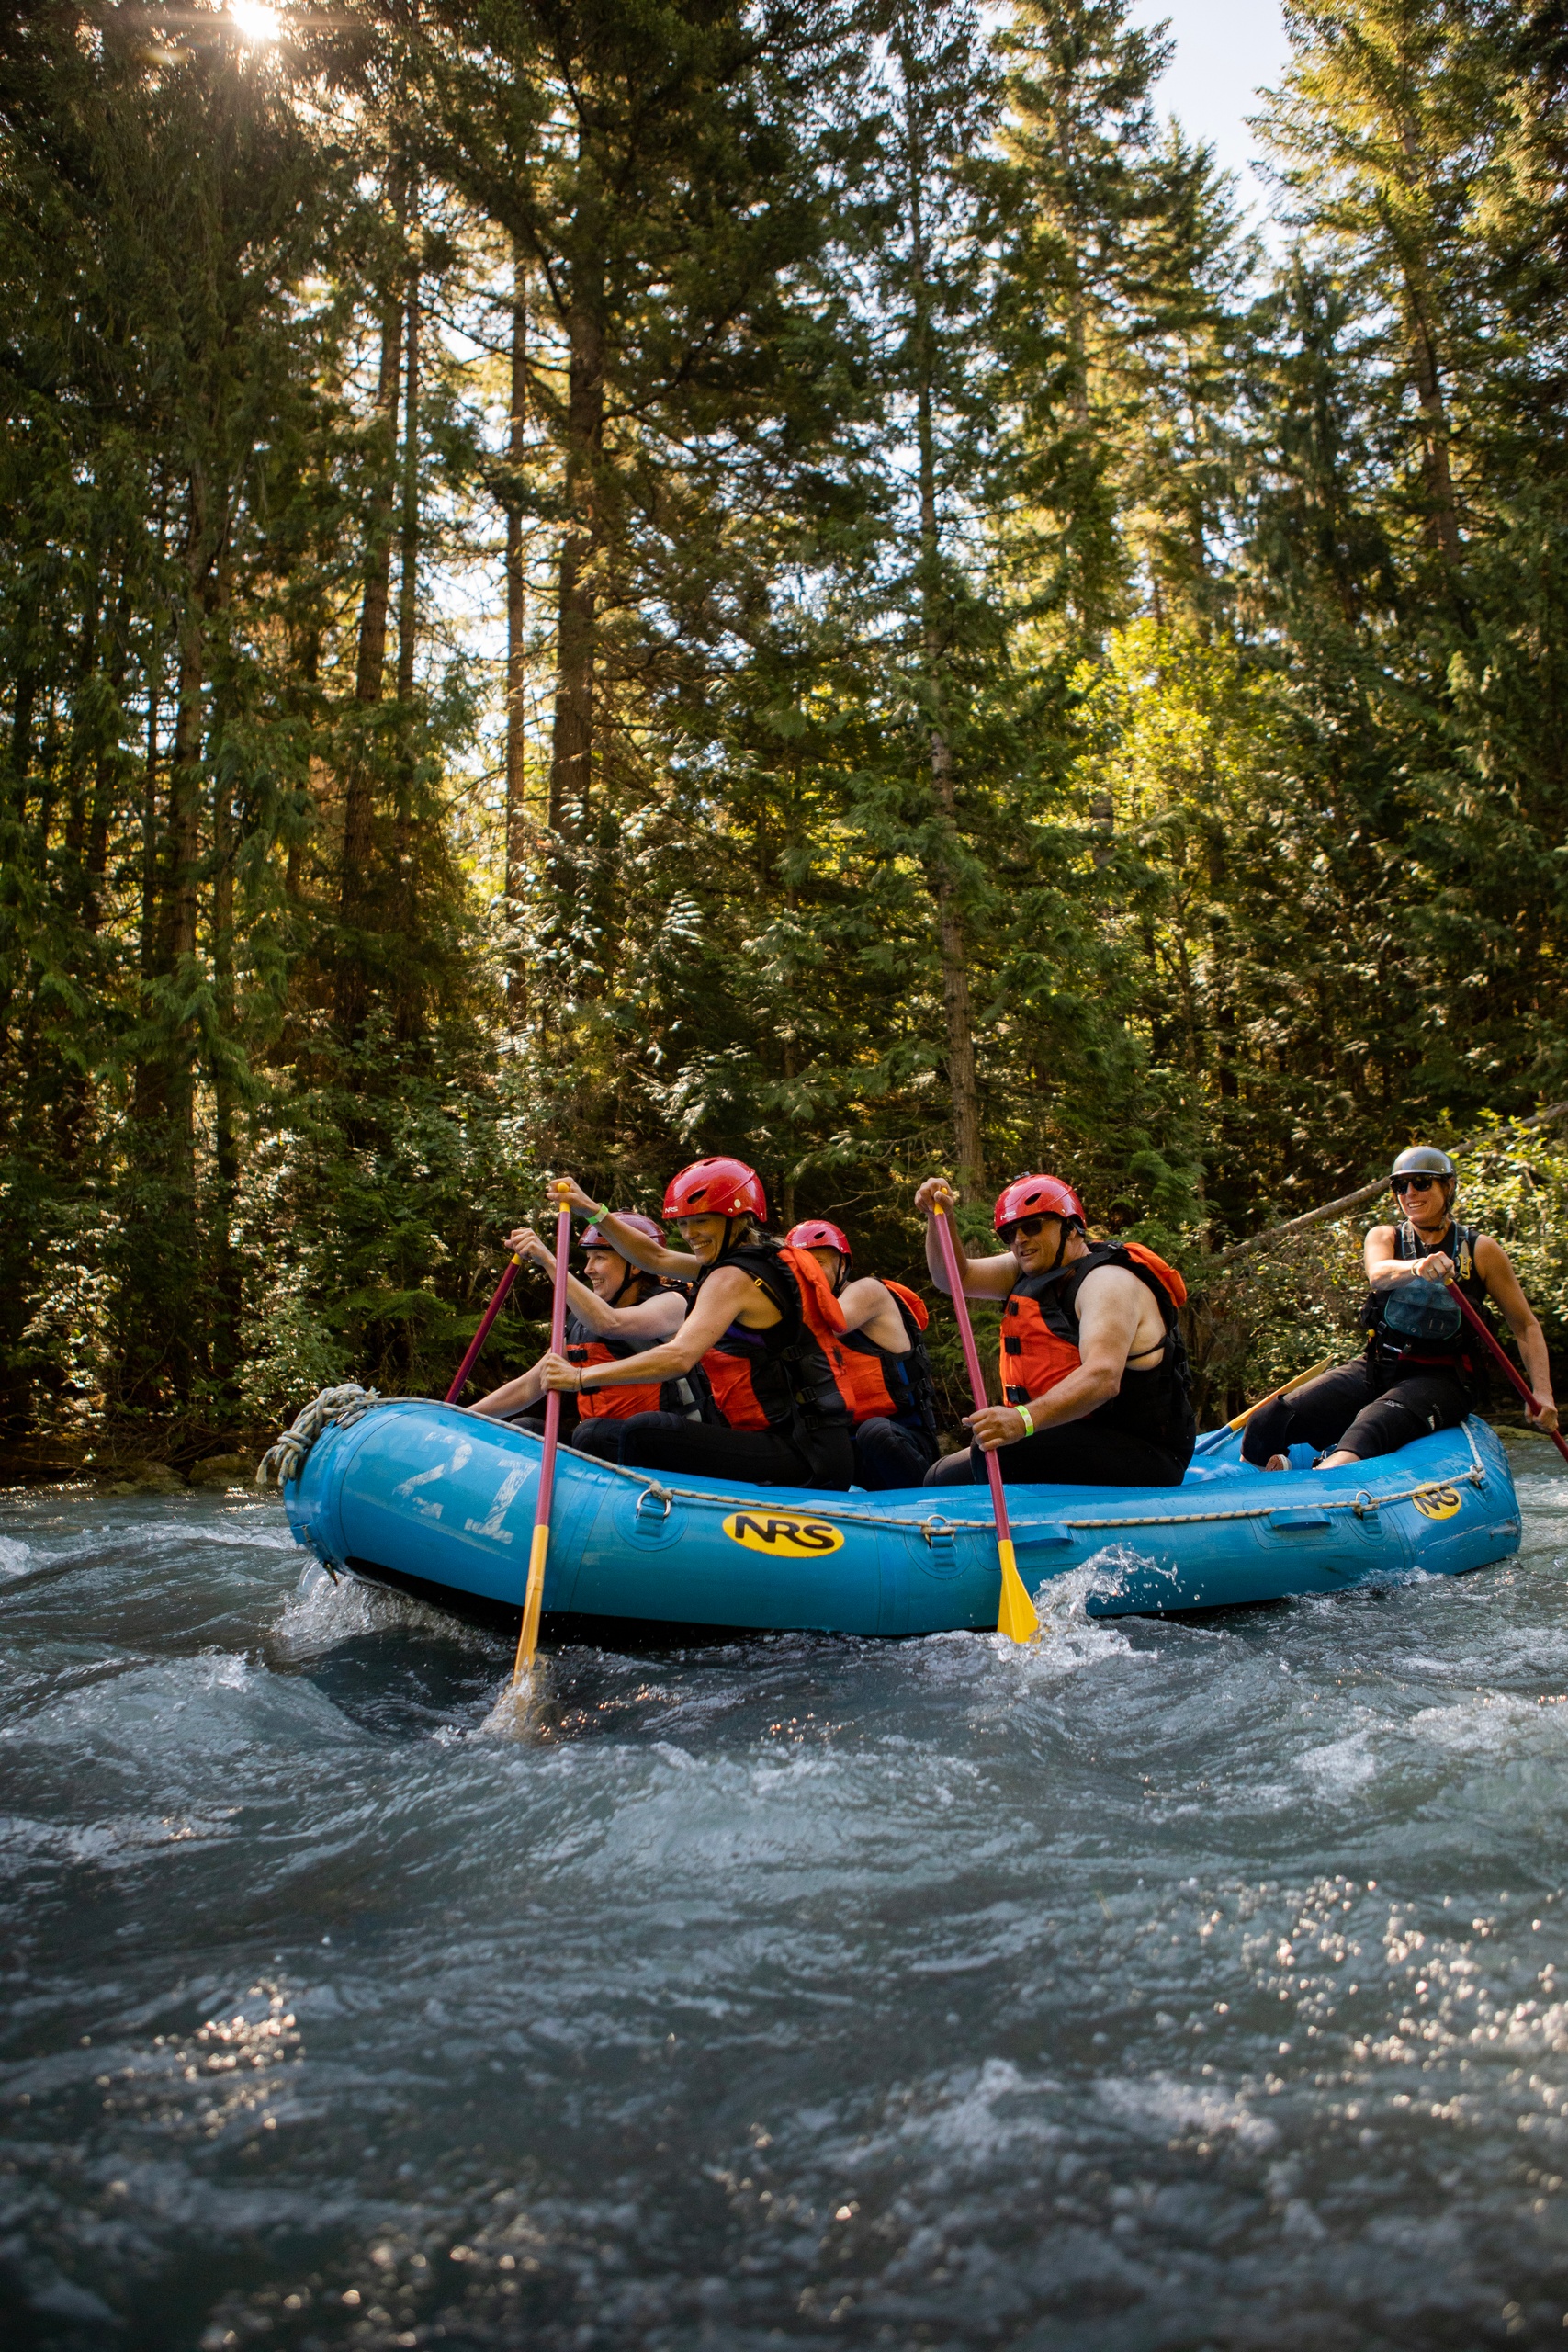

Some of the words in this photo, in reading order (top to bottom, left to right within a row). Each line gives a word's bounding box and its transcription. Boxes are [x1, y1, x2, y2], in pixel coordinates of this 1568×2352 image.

[1000, 1210, 1016, 1220] NRS
[1414, 1486, 1460, 1515] NRS
[734, 1515, 835, 1550] NRS
